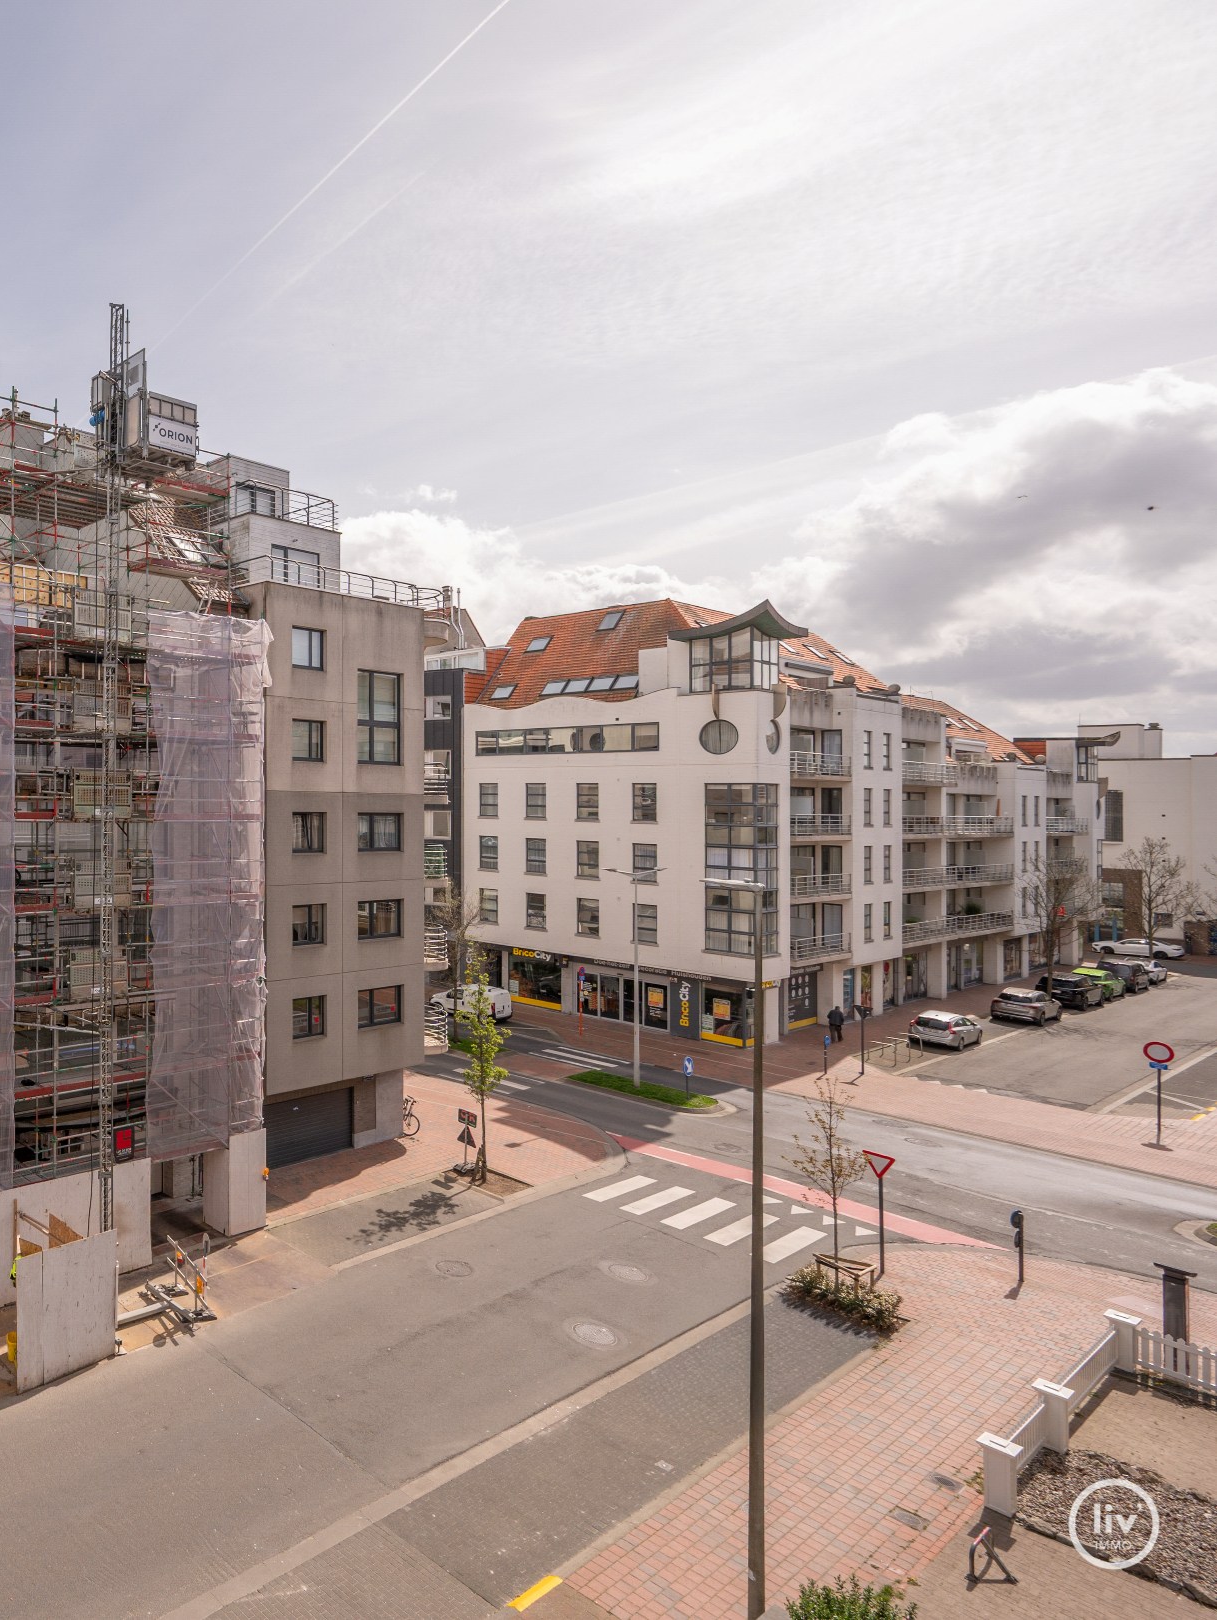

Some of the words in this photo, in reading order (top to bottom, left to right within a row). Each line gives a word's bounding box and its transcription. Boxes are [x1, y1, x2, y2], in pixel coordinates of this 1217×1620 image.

[159, 428, 193, 445] ORION
[512, 947, 551, 962] BricoCity
[679, 981, 691, 1027] BricoCity
